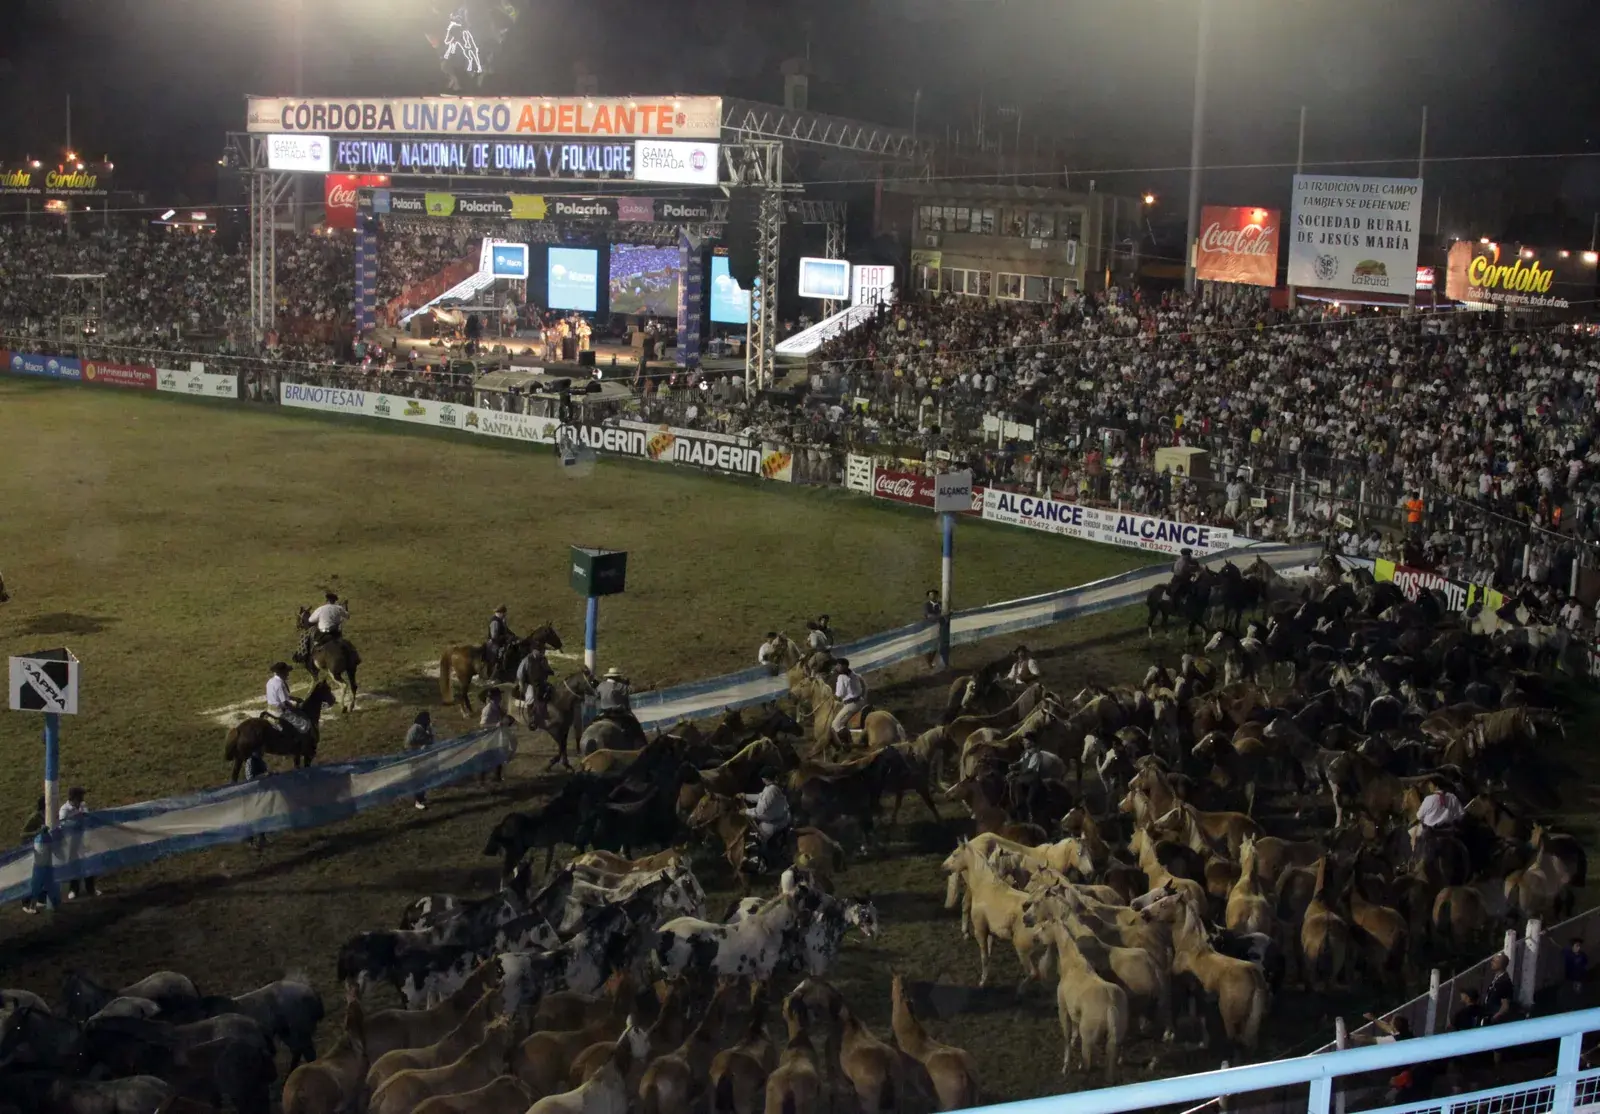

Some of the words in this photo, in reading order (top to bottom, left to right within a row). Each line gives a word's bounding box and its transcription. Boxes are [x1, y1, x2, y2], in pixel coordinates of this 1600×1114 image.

[281, 100, 396, 130] CÓRDOBA
[515, 104, 674, 134] ADELANTE
[274, 140, 299, 149] GAMA
[274, 149, 307, 159] STRADA
[642, 147, 674, 158] GAMA
[339, 141, 396, 165] FESTIVAL
[401, 143, 466, 168] NACIONAL
[473, 144, 489, 169] DE
[494, 143, 536, 170] DOMA
[544, 144, 554, 169] Y
[561, 145, 631, 172] FOLKLORE
[642, 157, 685, 169] STRADA
[1298, 181, 1309, 191] LA
[1362, 184, 1381, 194] DEL
[1381, 185, 1418, 196] CAMPO
[1345, 198, 1357, 208] SE
[1297, 214, 1361, 230] SOCIEDAD
[1366, 218, 1413, 233] RURAL
[1297, 231, 1315, 243] DE
[1319, 231, 1360, 247] JESÚS
[1365, 235, 1410, 251] MARÍA
[860, 267, 885, 286] FIAT
[860, 286, 885, 304] FIAT
[1467, 287, 1485, 299] Todo
[1484, 290, 1491, 300] lo
[1491, 292, 1504, 302] que
[1530, 295, 1547, 305] todo
[1547, 296, 1555, 306] el
[24, 362, 44, 372] Macro
[60, 366, 80, 376] Macro
[285, 385, 365, 407] BRUNOTESAN
[482, 417, 514, 436] SANTA
[515, 423, 539, 440] ANA
[674, 437, 762, 475] MADERIN
[997, 493, 1083, 526] ALCANCE
[995, 513, 1018, 523] Llame
[1028, 519, 1050, 530] 03472
[1055, 525, 1082, 535] 481281
[1115, 515, 1211, 547] ALCANCE
[1114, 536, 1138, 547] Llame
[1148, 542, 1173, 553] 03472
